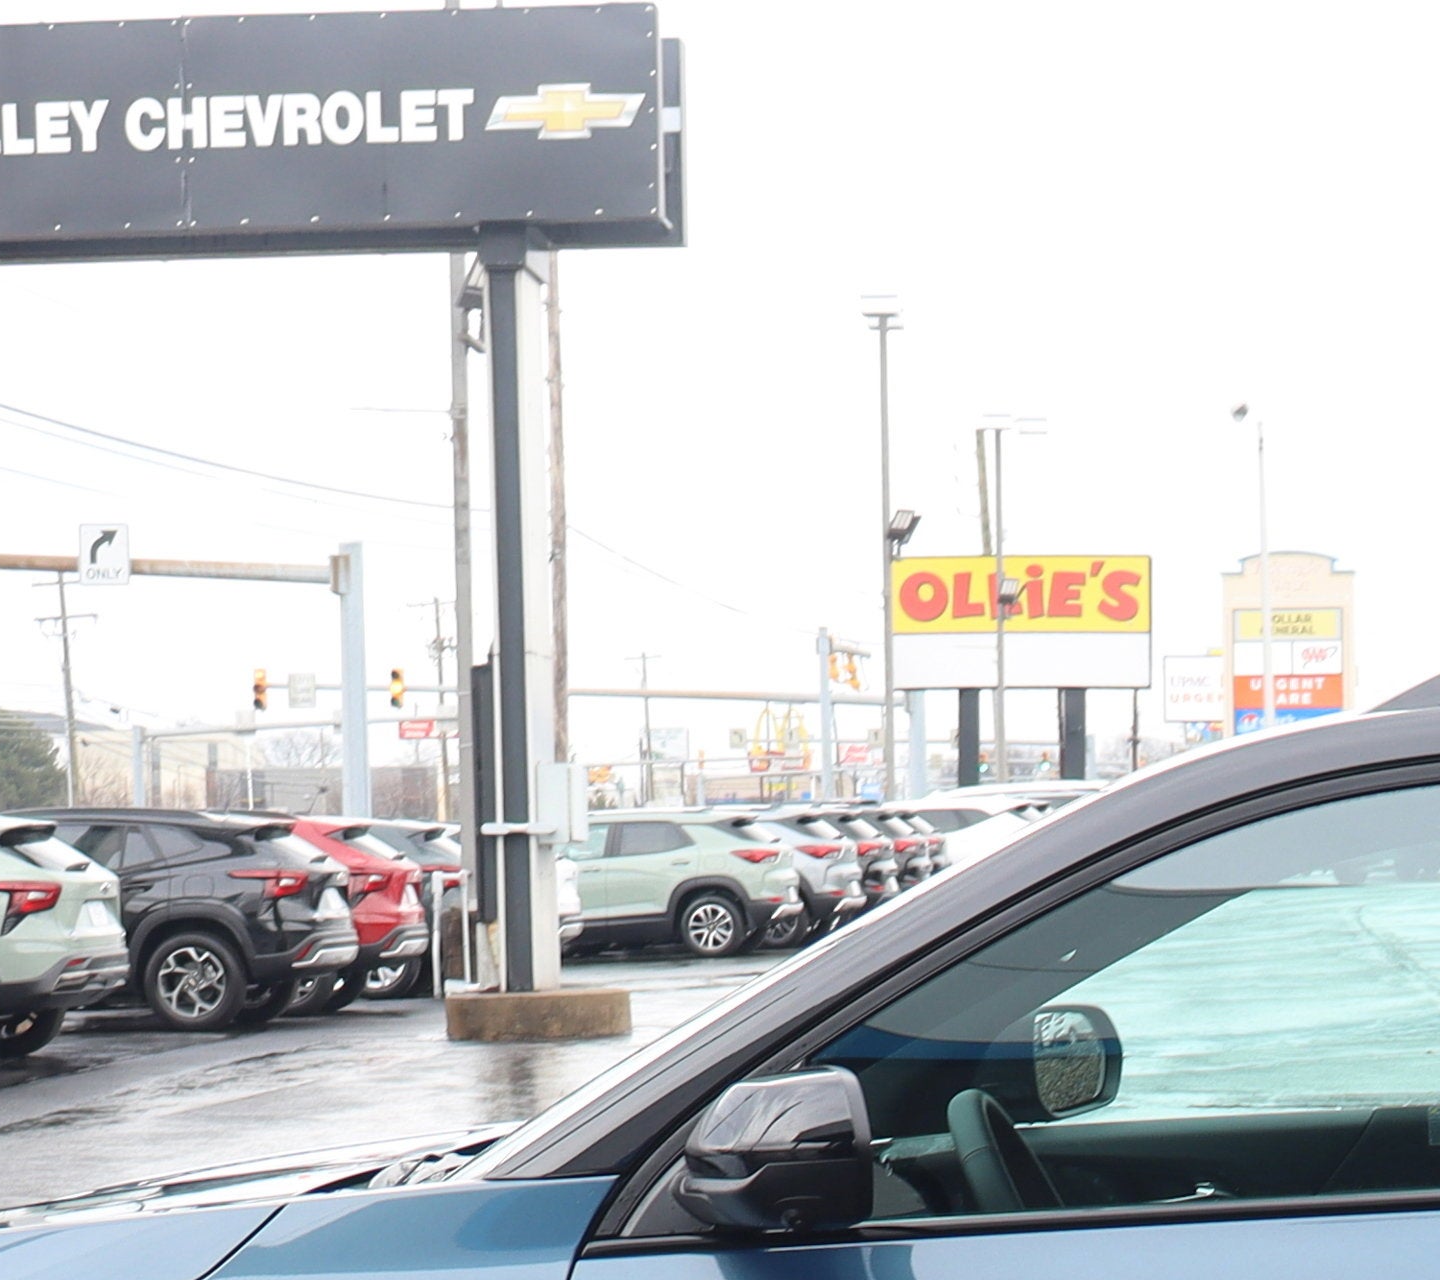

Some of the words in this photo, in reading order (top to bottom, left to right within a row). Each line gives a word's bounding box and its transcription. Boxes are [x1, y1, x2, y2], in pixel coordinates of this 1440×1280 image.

[124, 88, 474, 154] CHEVROLET
[86, 568, 123, 580] ONLY
[1266, 612, 1313, 625] OLLAR
[1250, 677, 1326, 690] UGENT
[1274, 693, 1312, 705] ARE
